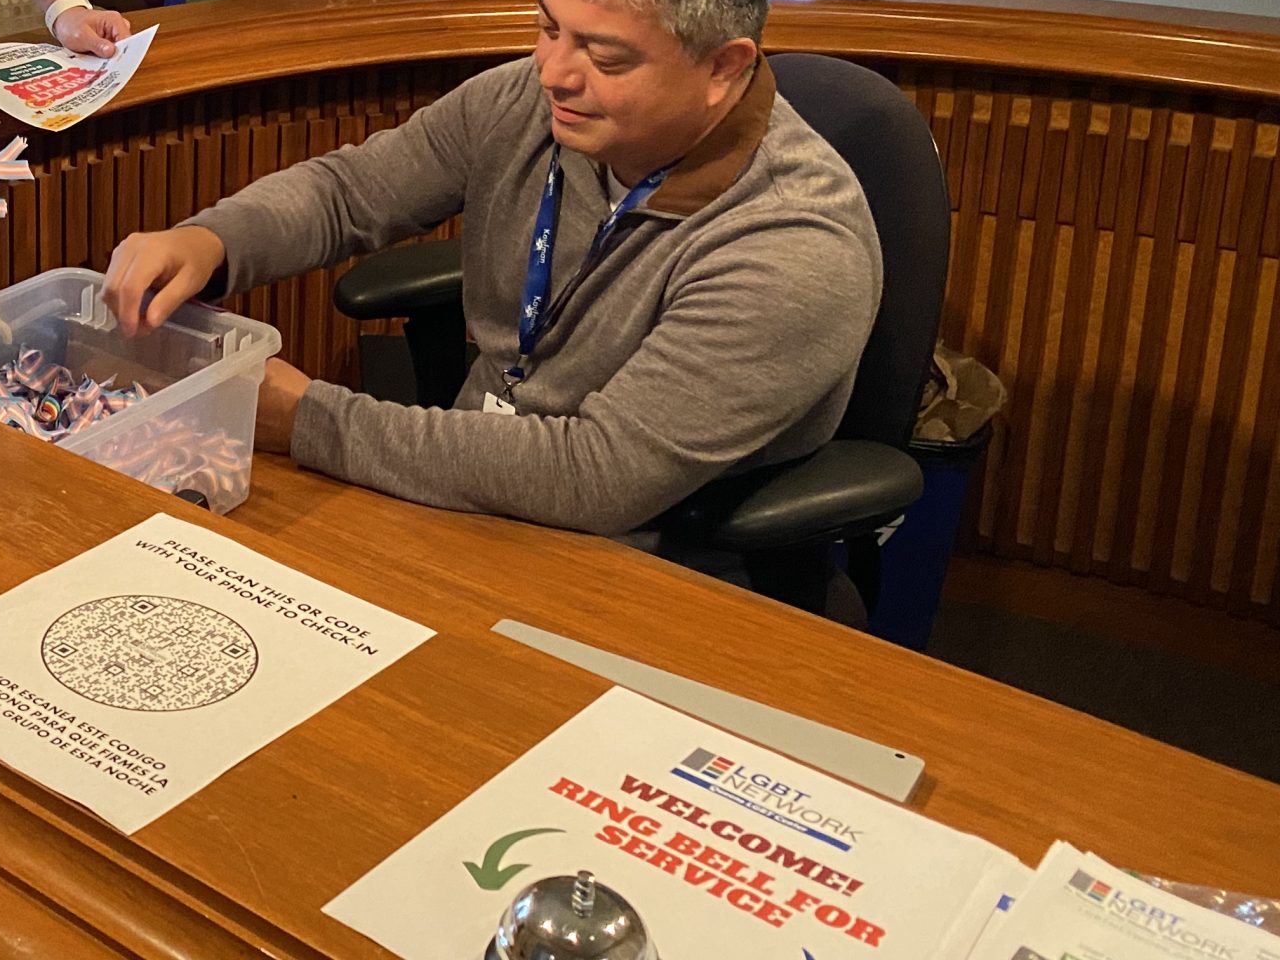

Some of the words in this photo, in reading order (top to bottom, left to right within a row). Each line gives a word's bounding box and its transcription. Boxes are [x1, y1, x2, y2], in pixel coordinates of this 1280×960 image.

[31, 73, 96, 101] PROJECT
[135, 540, 174, 558] WITH
[175, 556, 218, 582] YOUR
[218, 580, 275, 608] PHONE
[275, 606, 298, 619] TO
[300, 618, 379, 655] CHECK-IN
[164, 539, 217, 567] PLEASE
[215, 565, 260, 588] SCAN
[260, 585, 296, 604] THIS
[297, 603, 322, 617] QR
[324, 615, 371, 639] CODE
[2, 709, 50, 738] GRUPO
[50, 737, 72, 750] DE
[69, 747, 102, 768] ESTA
[103, 766, 157, 795] NOCHE
[19, 689, 77, 724] ESCANEA
[77, 721, 110, 740] ESTE
[108, 739, 166, 770] CODIGO
[30, 710, 67, 733] PARA
[69, 732, 100, 751] QUE
[98, 748, 150, 776] FIRMES
[149, 773, 168, 788] LA
[722, 774, 864, 843] NETWORK
[734, 765, 811, 803] LGBT
[548, 777, 663, 839] RING
[664, 832, 776, 896] BELL
[785, 888, 886, 948] FOR
[594, 825, 794, 928] SERVICE
[619, 774, 865, 898] WELCOME!
[1108, 898, 1242, 960] NETWORK
[1113, 890, 1187, 925] LGBT
